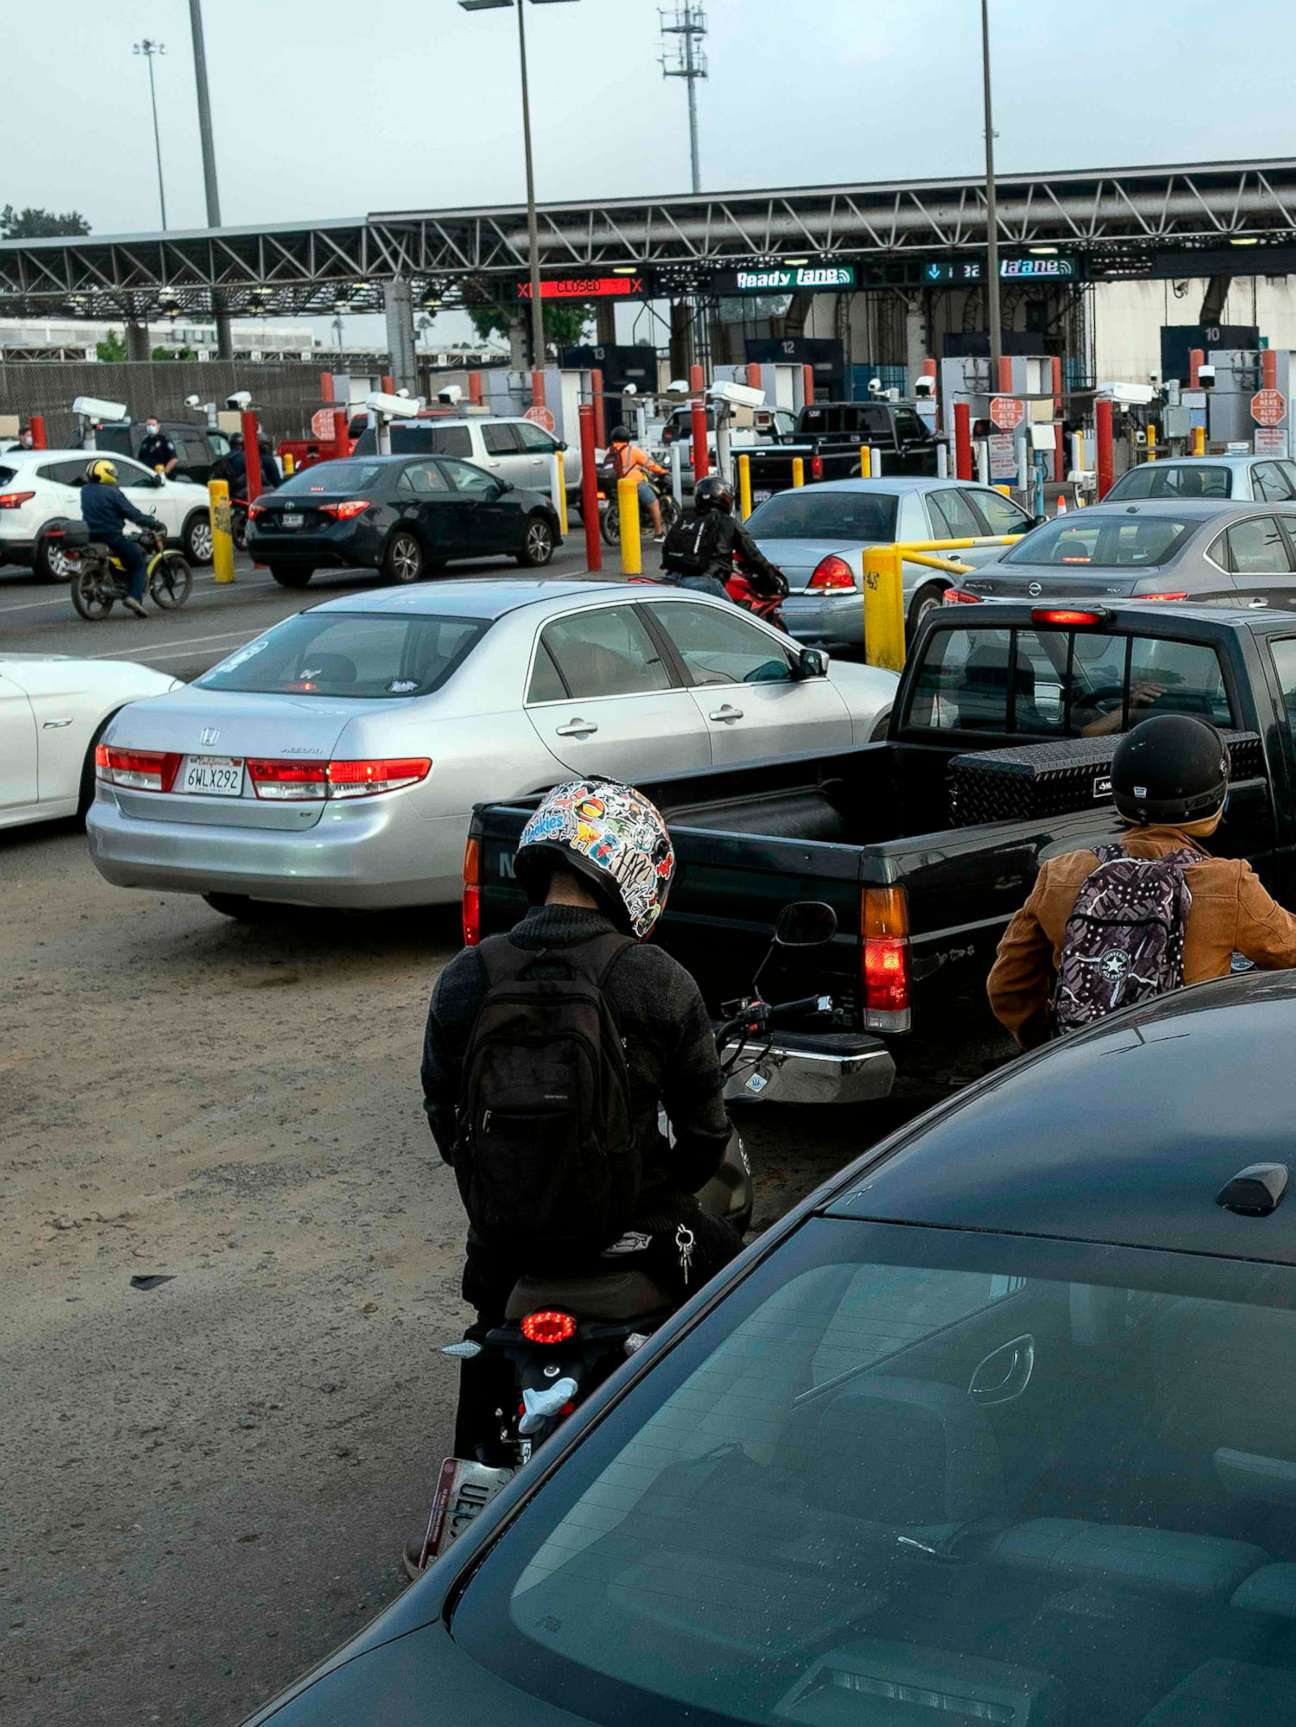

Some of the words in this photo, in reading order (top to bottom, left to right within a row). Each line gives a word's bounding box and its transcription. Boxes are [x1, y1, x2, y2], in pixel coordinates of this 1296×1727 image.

[556, 279, 601, 293] CLOSED
[737, 270, 791, 288] Ready
[1205, 327, 1220, 342] 10
[592, 347, 606, 361] 13
[782, 341, 795, 354] 12
[1259, 391, 1277, 399] STOP
[187, 767, 239, 790] 6WLX292
